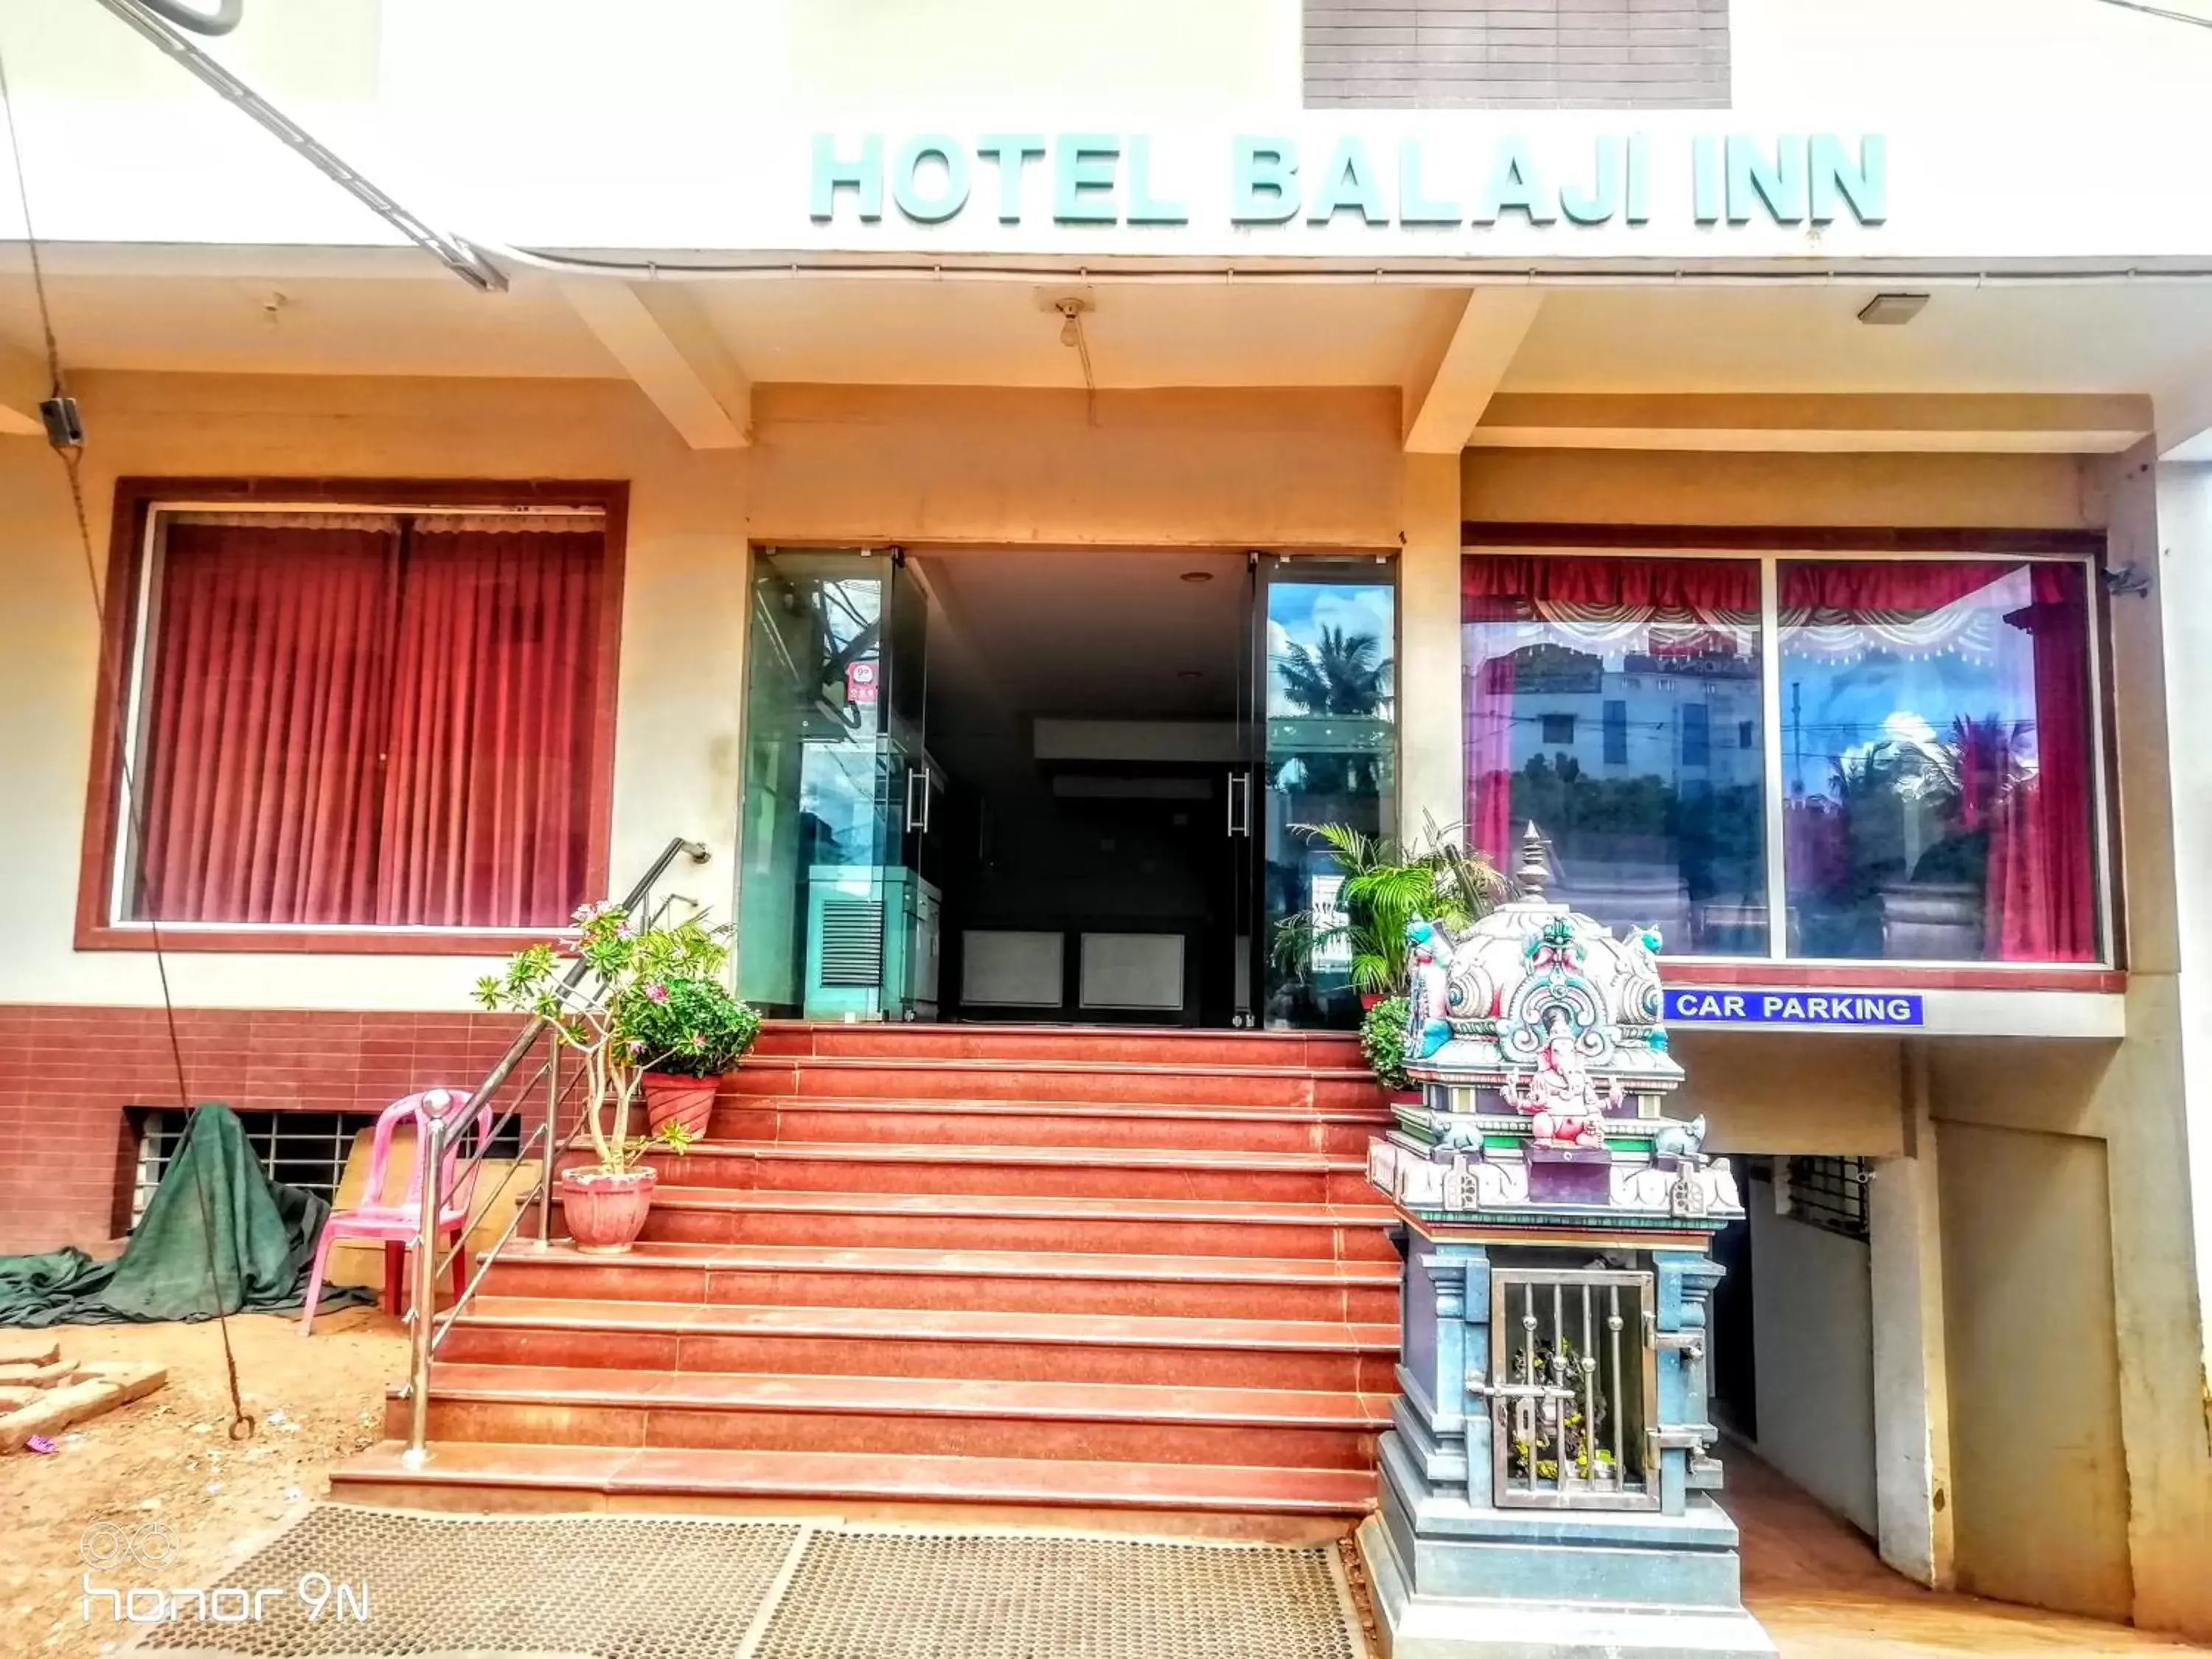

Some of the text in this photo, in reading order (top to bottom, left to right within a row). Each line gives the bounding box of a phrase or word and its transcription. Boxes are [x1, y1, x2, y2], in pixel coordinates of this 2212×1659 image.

[810, 133, 1888, 226] HOTEL BALAJI INN
[1676, 995, 1911, 1020] CAR PARKING
